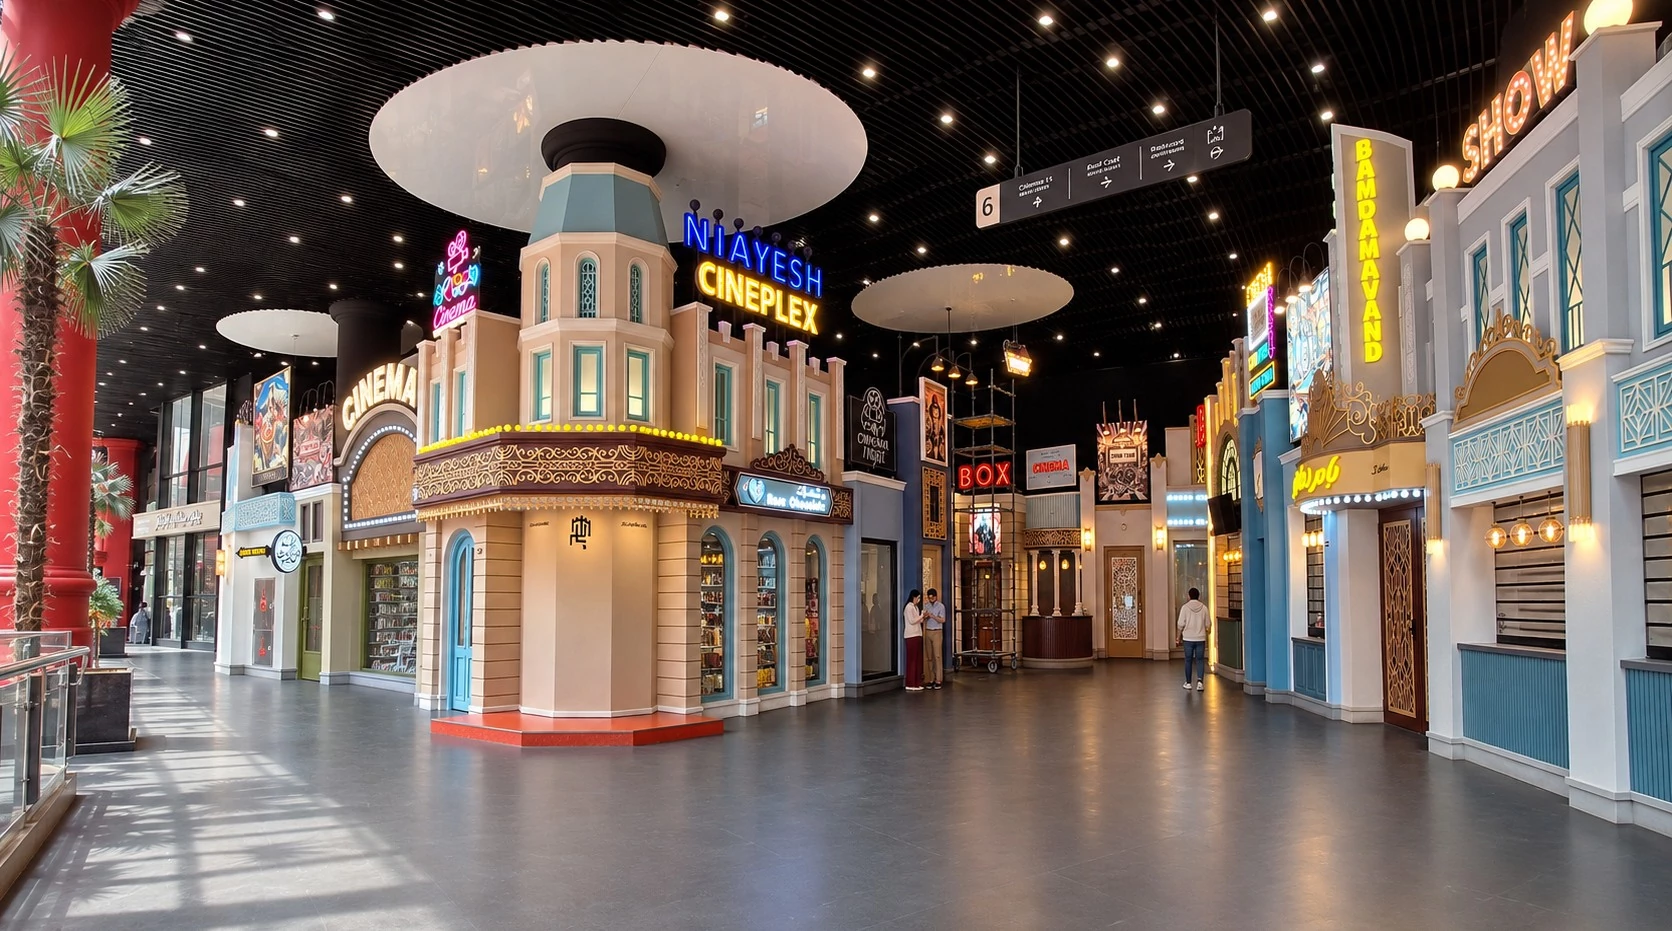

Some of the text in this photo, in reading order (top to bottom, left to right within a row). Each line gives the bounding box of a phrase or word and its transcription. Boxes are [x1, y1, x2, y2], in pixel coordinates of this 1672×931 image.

[1462, 10, 1575, 184] SHOW
[982, 196, 993, 216] 6
[684, 212, 823, 299] NIAYESH
[1355, 138, 1383, 363] BAMDAMAVAND
[433, 295, 476, 329] Cinema
[697, 260, 819, 335] CINEPLEX
[342, 362, 417, 431] CINEMA
[958, 461, 1011, 489] BOX
